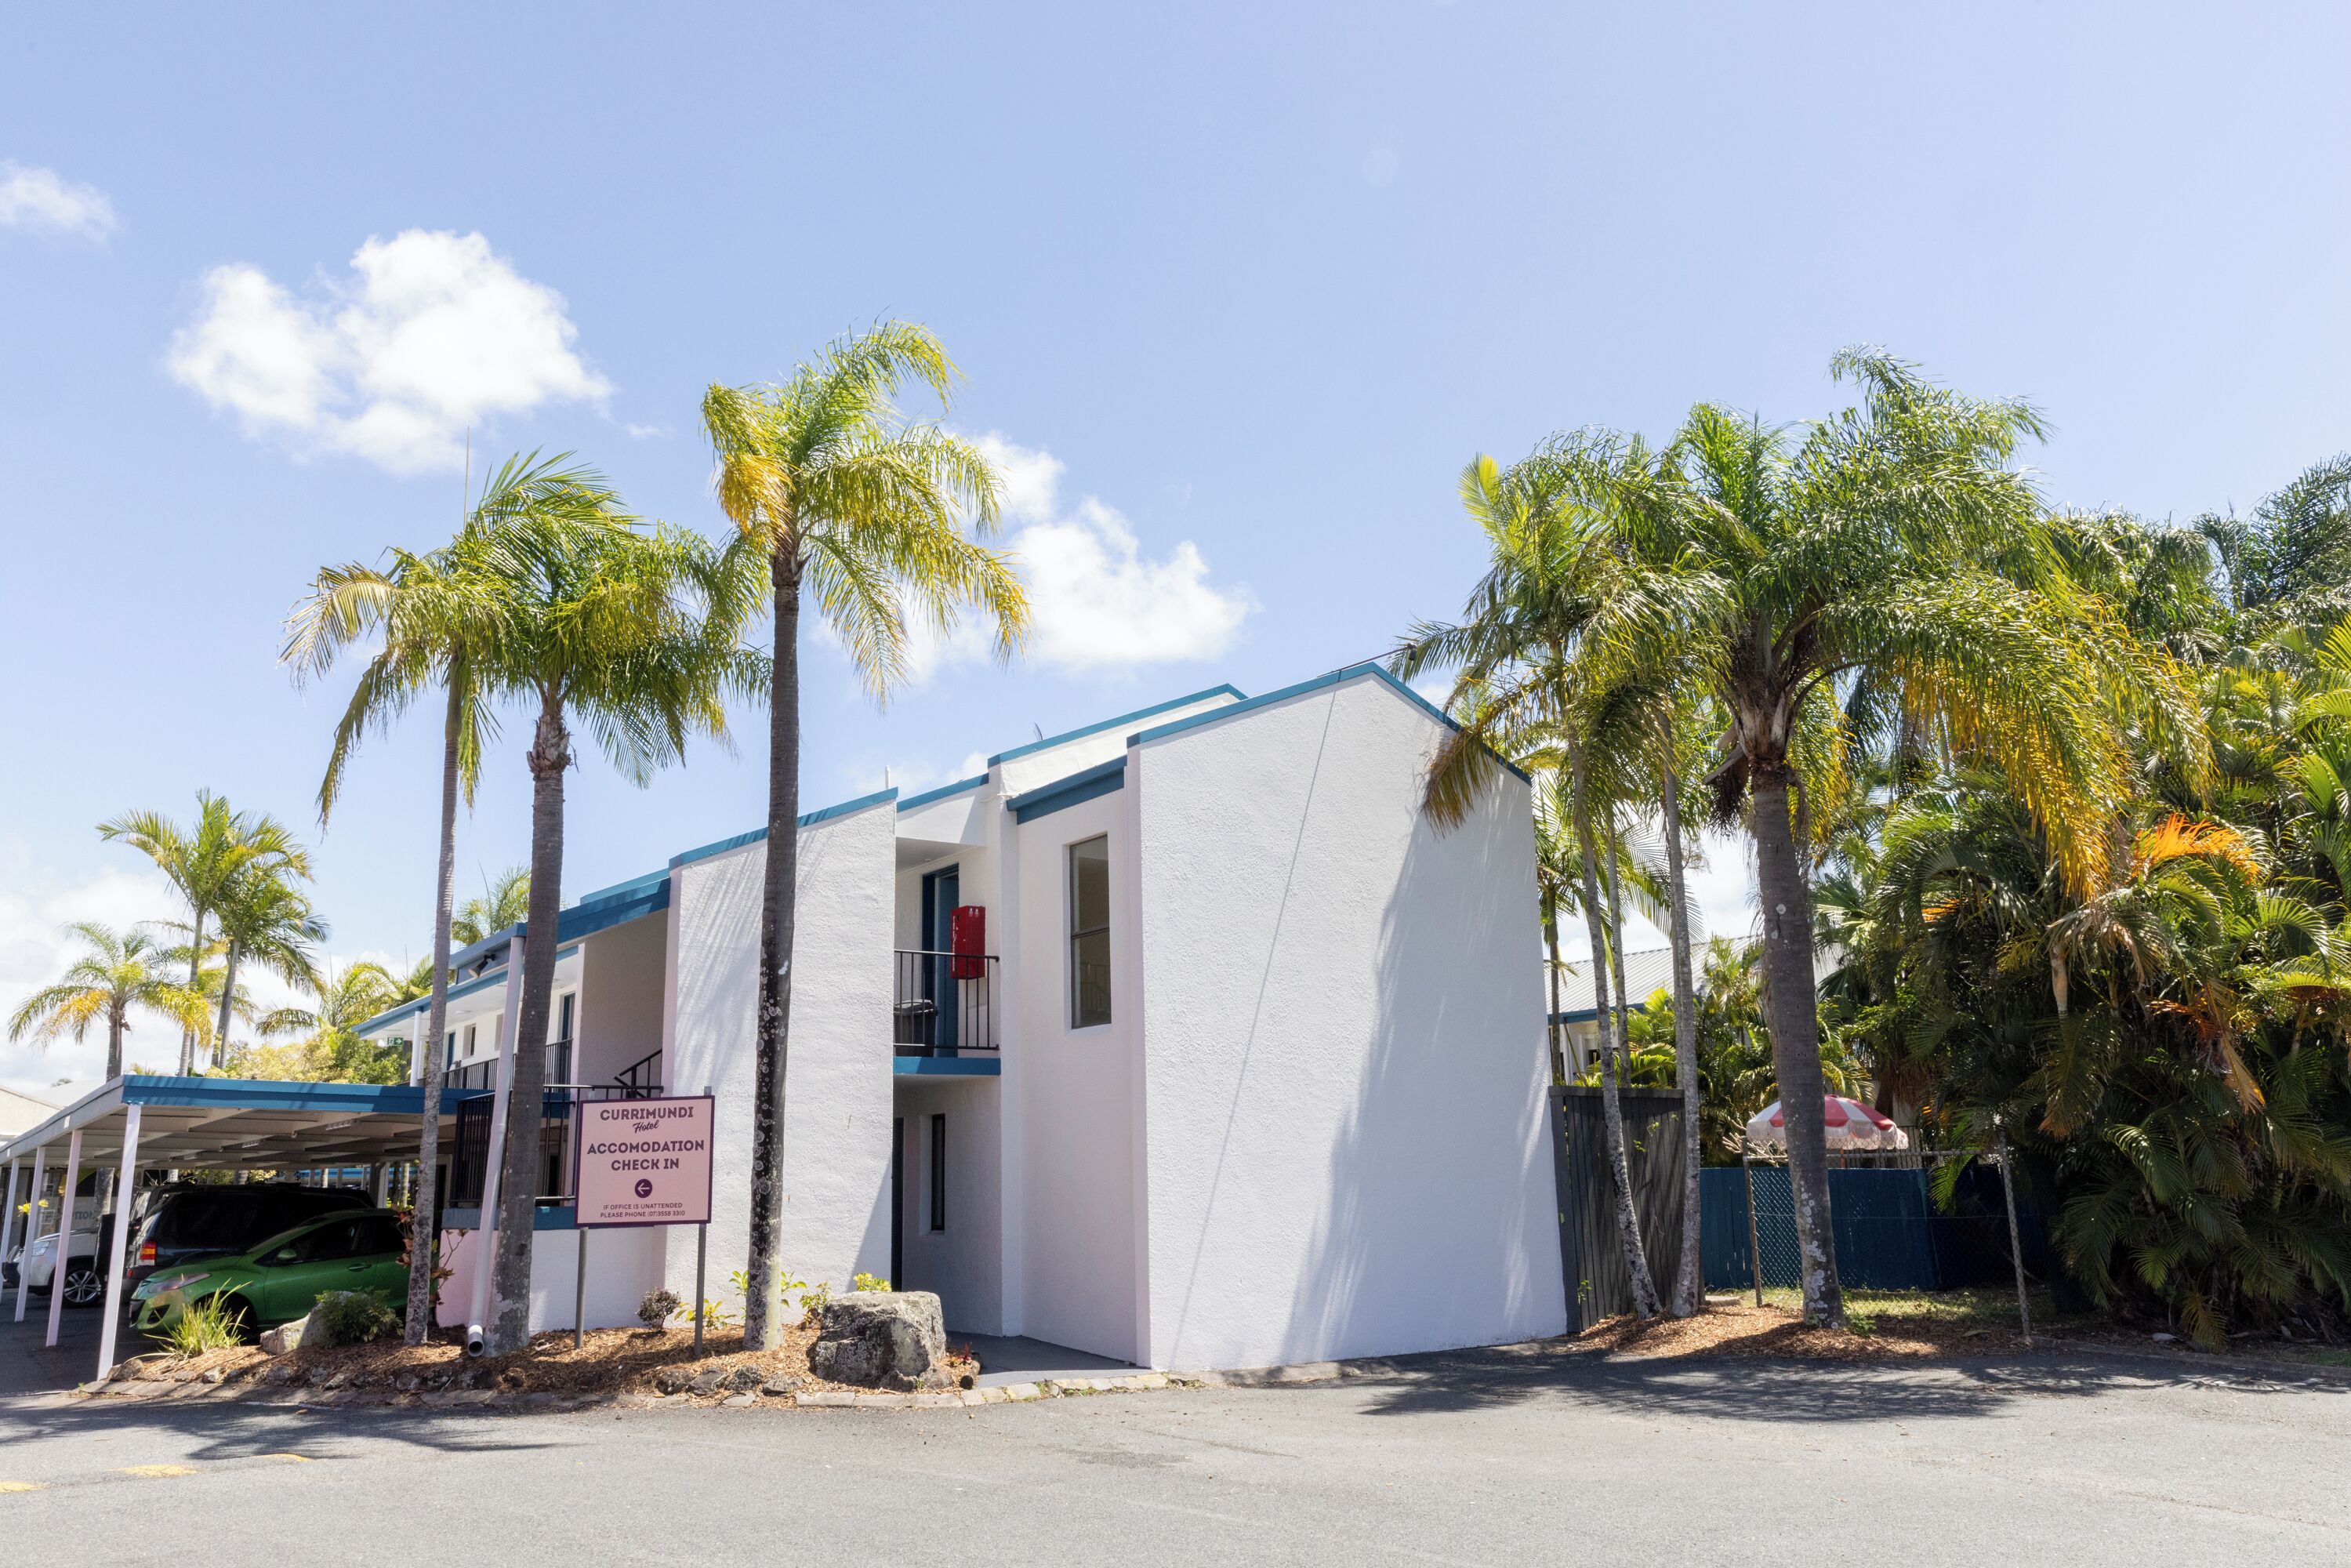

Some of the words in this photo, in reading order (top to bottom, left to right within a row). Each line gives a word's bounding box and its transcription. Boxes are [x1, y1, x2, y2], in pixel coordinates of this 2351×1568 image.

[600, 1106, 694, 1120] CURRIMUNDI
[633, 1120, 660, 1134] Hotel
[587, 1139, 705, 1154] ACCOMODATION
[611, 1158, 660, 1171] CHECK
[663, 1158, 679, 1170] IN
